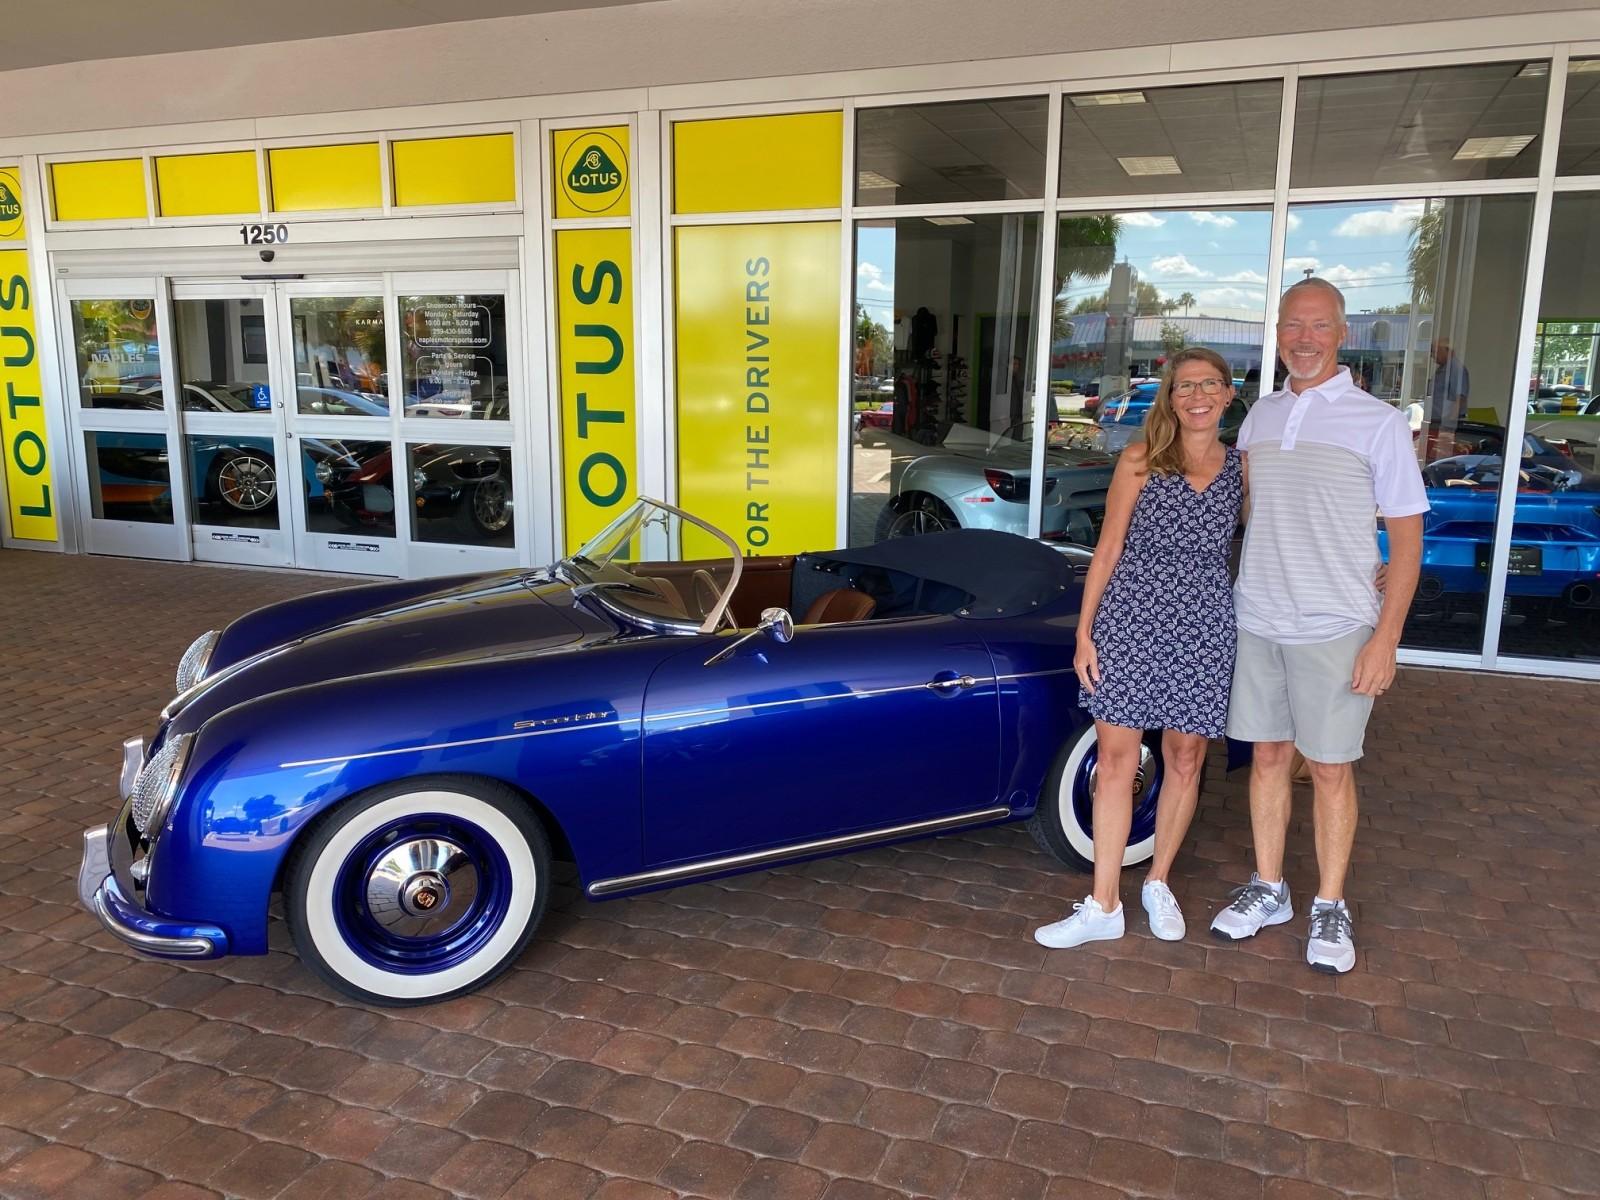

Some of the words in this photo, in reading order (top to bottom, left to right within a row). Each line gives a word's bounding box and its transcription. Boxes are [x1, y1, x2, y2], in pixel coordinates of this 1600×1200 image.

[571, 171, 619, 187] LOTUS
[0, 204, 20, 215] TUS
[239, 224, 289, 245] 1250
[424, 310, 448, 319] Monday
[452, 310, 479, 318] Saturday
[746, 256, 770, 413] DRIVERS
[91, 353, 145, 364] NAPLES
[0, 274, 52, 518] LOTUS
[746, 425, 769, 491] THE
